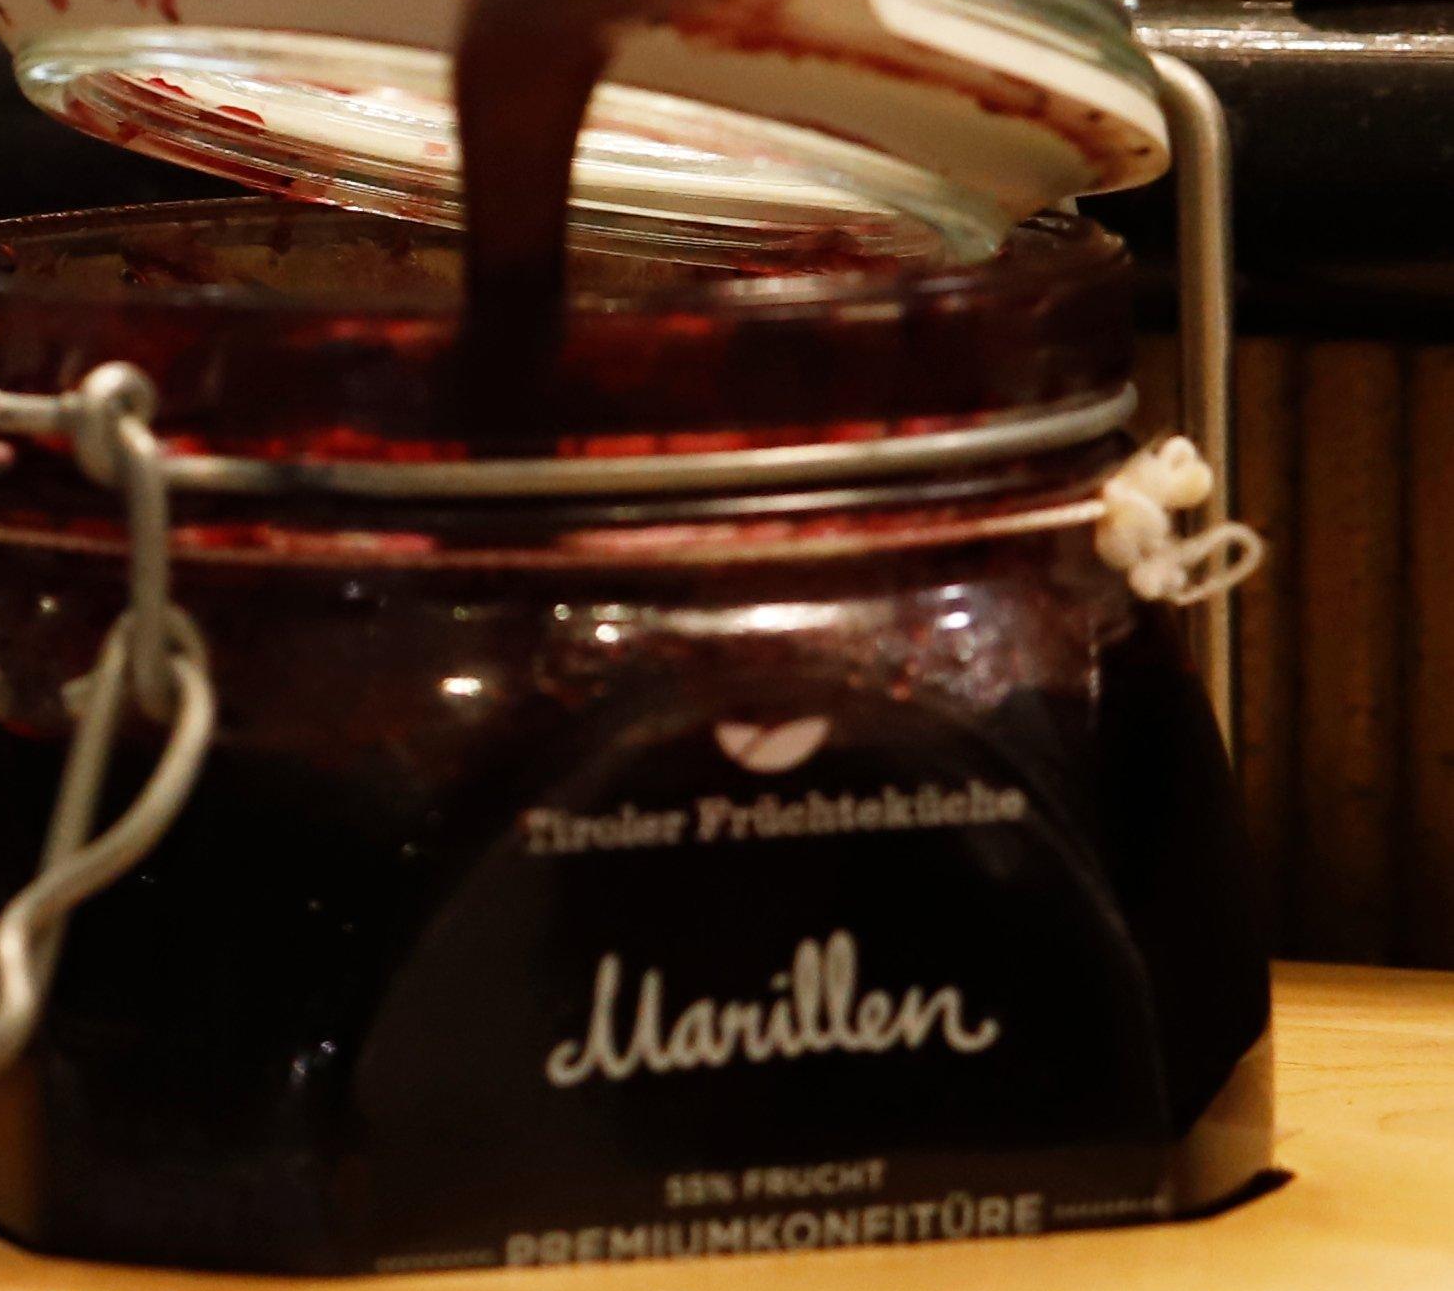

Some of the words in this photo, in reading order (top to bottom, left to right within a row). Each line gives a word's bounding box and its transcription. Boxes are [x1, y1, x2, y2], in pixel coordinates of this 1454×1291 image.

[526, 803, 684, 855] Tiroler
[546, 929, 1001, 1089] Marillen
[742, 1158, 888, 1199] FRUCHT
[504, 1189, 1042, 1267] PREMIUMKONFITÜRE
